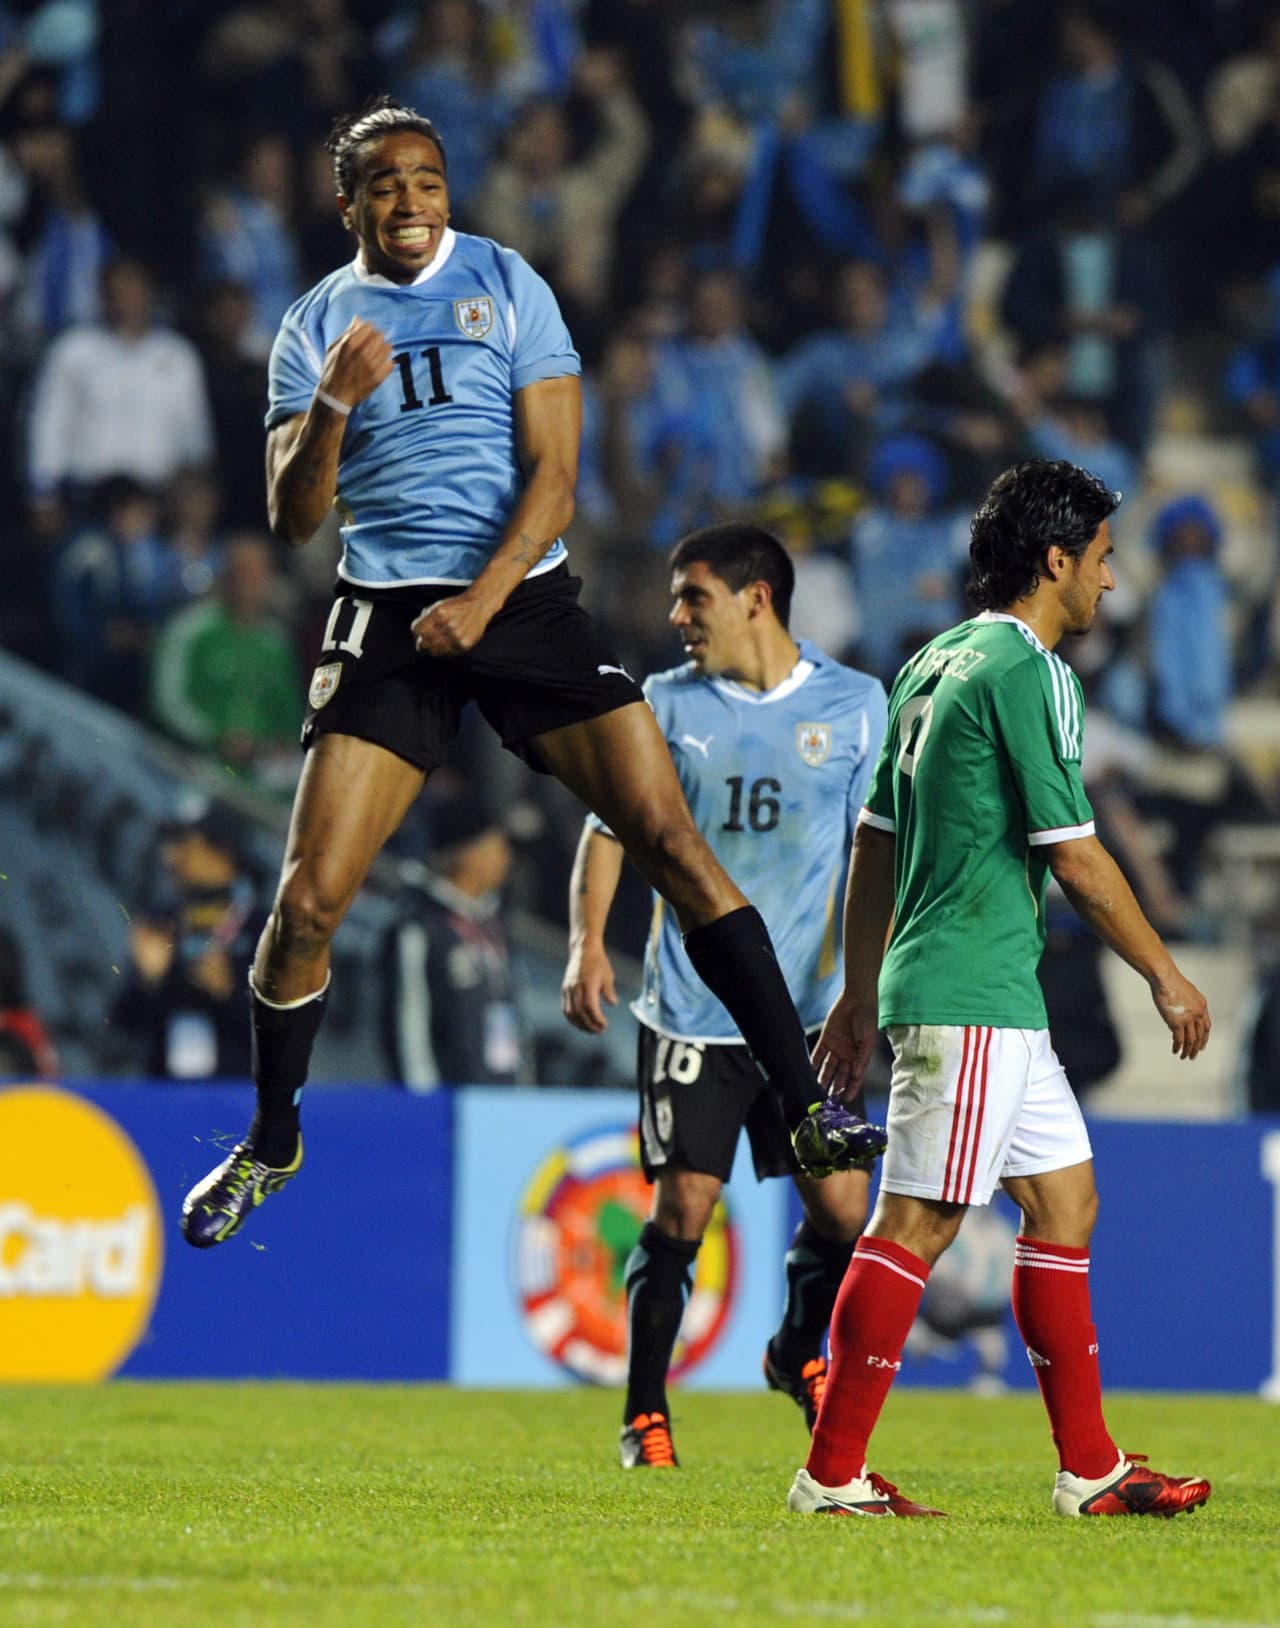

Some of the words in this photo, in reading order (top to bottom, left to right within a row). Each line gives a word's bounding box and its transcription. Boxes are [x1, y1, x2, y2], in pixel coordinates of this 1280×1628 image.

[393, 347, 453, 412] 11
[322, 597, 374, 658] 11
[722, 776, 781, 832] 16
[653, 1036, 706, 1085] 16
